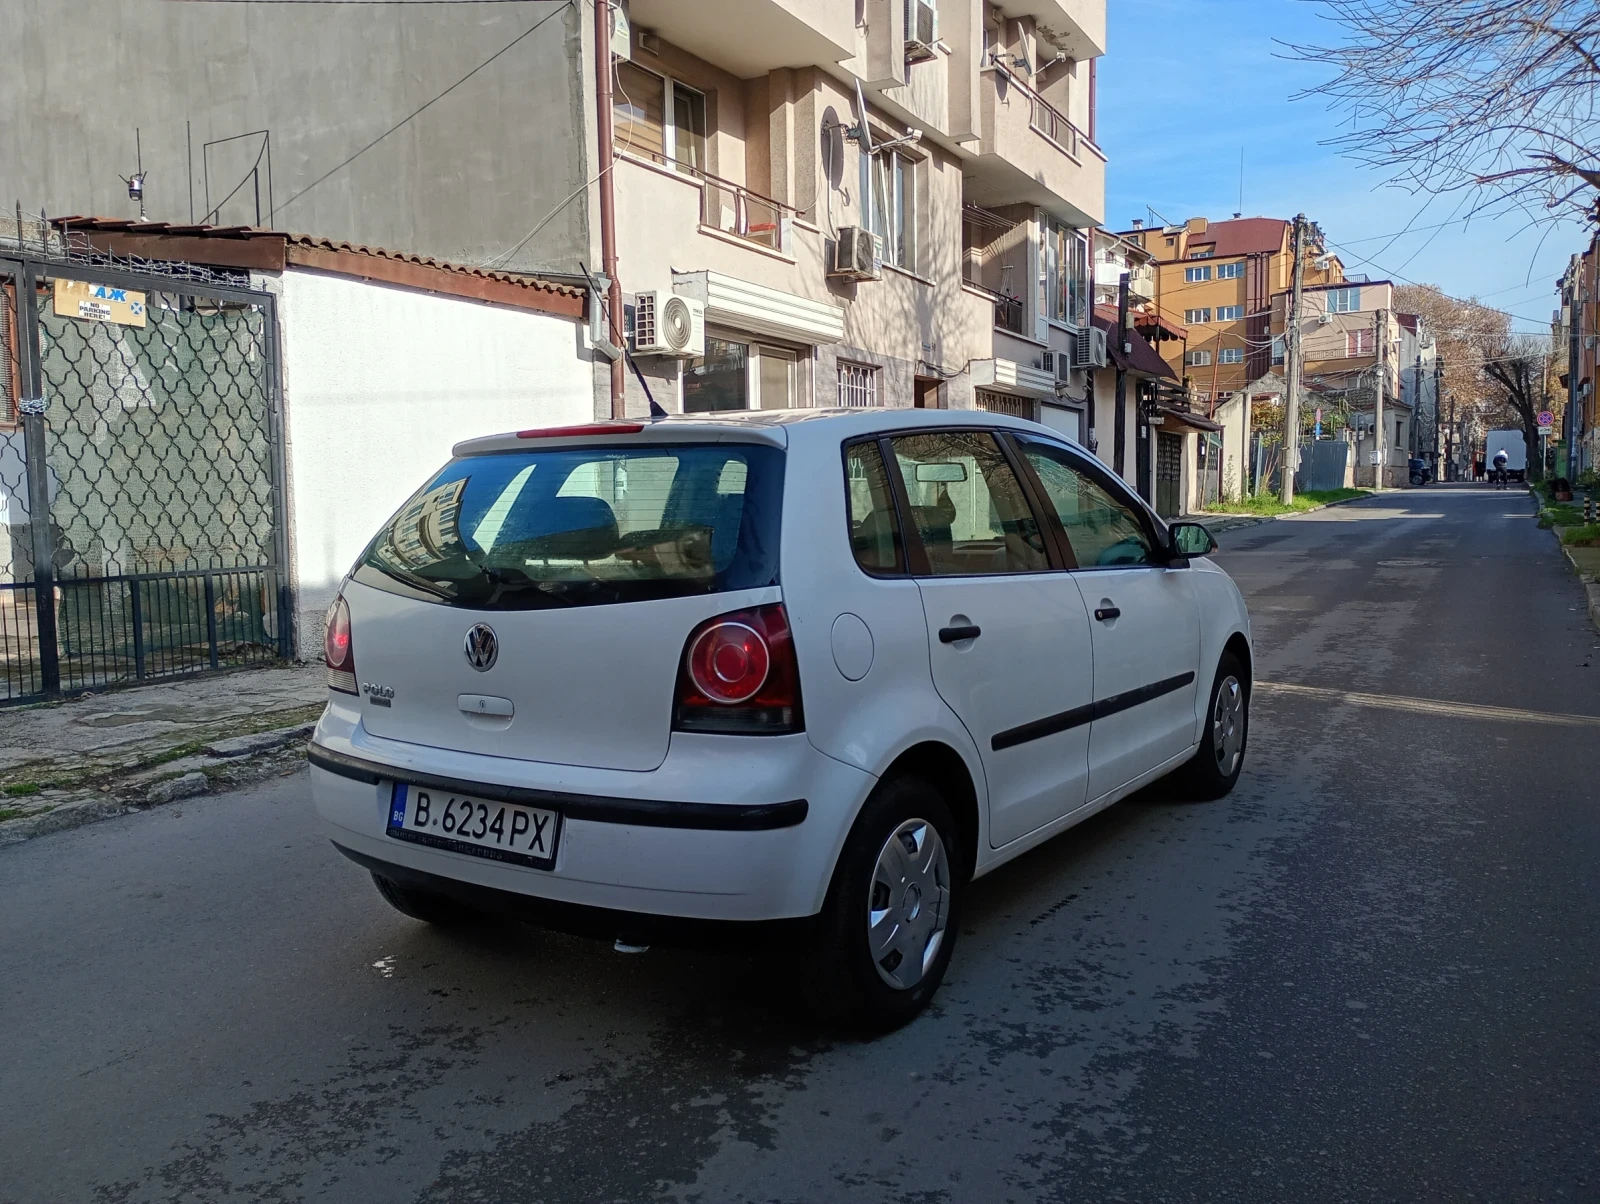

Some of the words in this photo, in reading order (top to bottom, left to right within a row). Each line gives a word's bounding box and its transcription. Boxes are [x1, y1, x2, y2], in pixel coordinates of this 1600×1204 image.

[79, 305, 111, 315] PARKING
[84, 312, 106, 320] HERE!
[363, 682, 395, 699] POLO
[393, 810, 404, 822] BG
